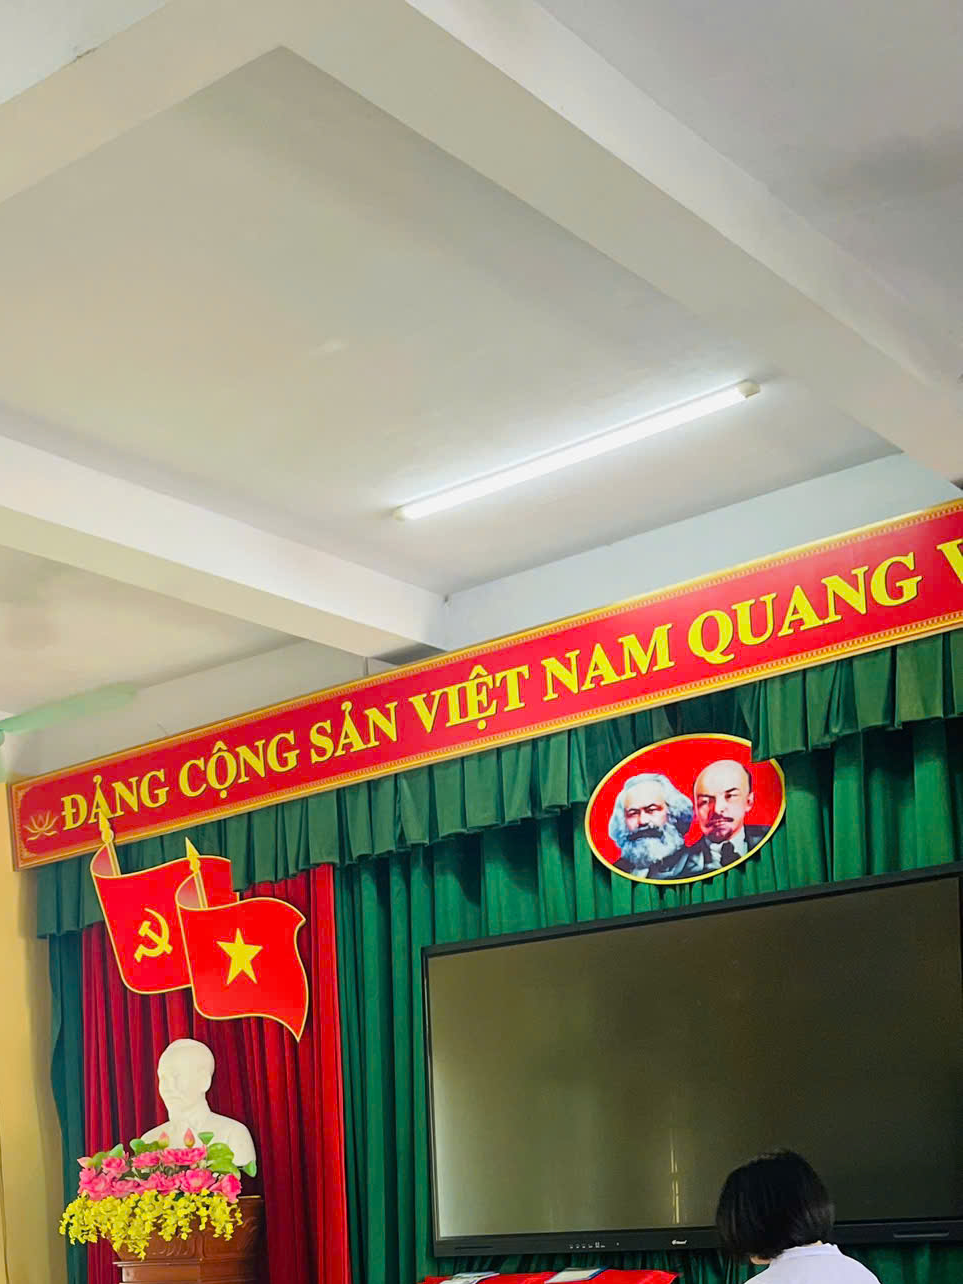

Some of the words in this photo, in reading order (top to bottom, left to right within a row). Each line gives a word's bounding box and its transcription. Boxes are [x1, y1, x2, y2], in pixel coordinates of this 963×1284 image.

[60, 769, 170, 831] ĐẢNG
[180, 732, 300, 799] CỘNG
[310, 701, 399, 765] SẢN
[408, 664, 531, 732] VIỆT
[540, 623, 676, 703] NAM
[687, 551, 923, 665] QUANG
